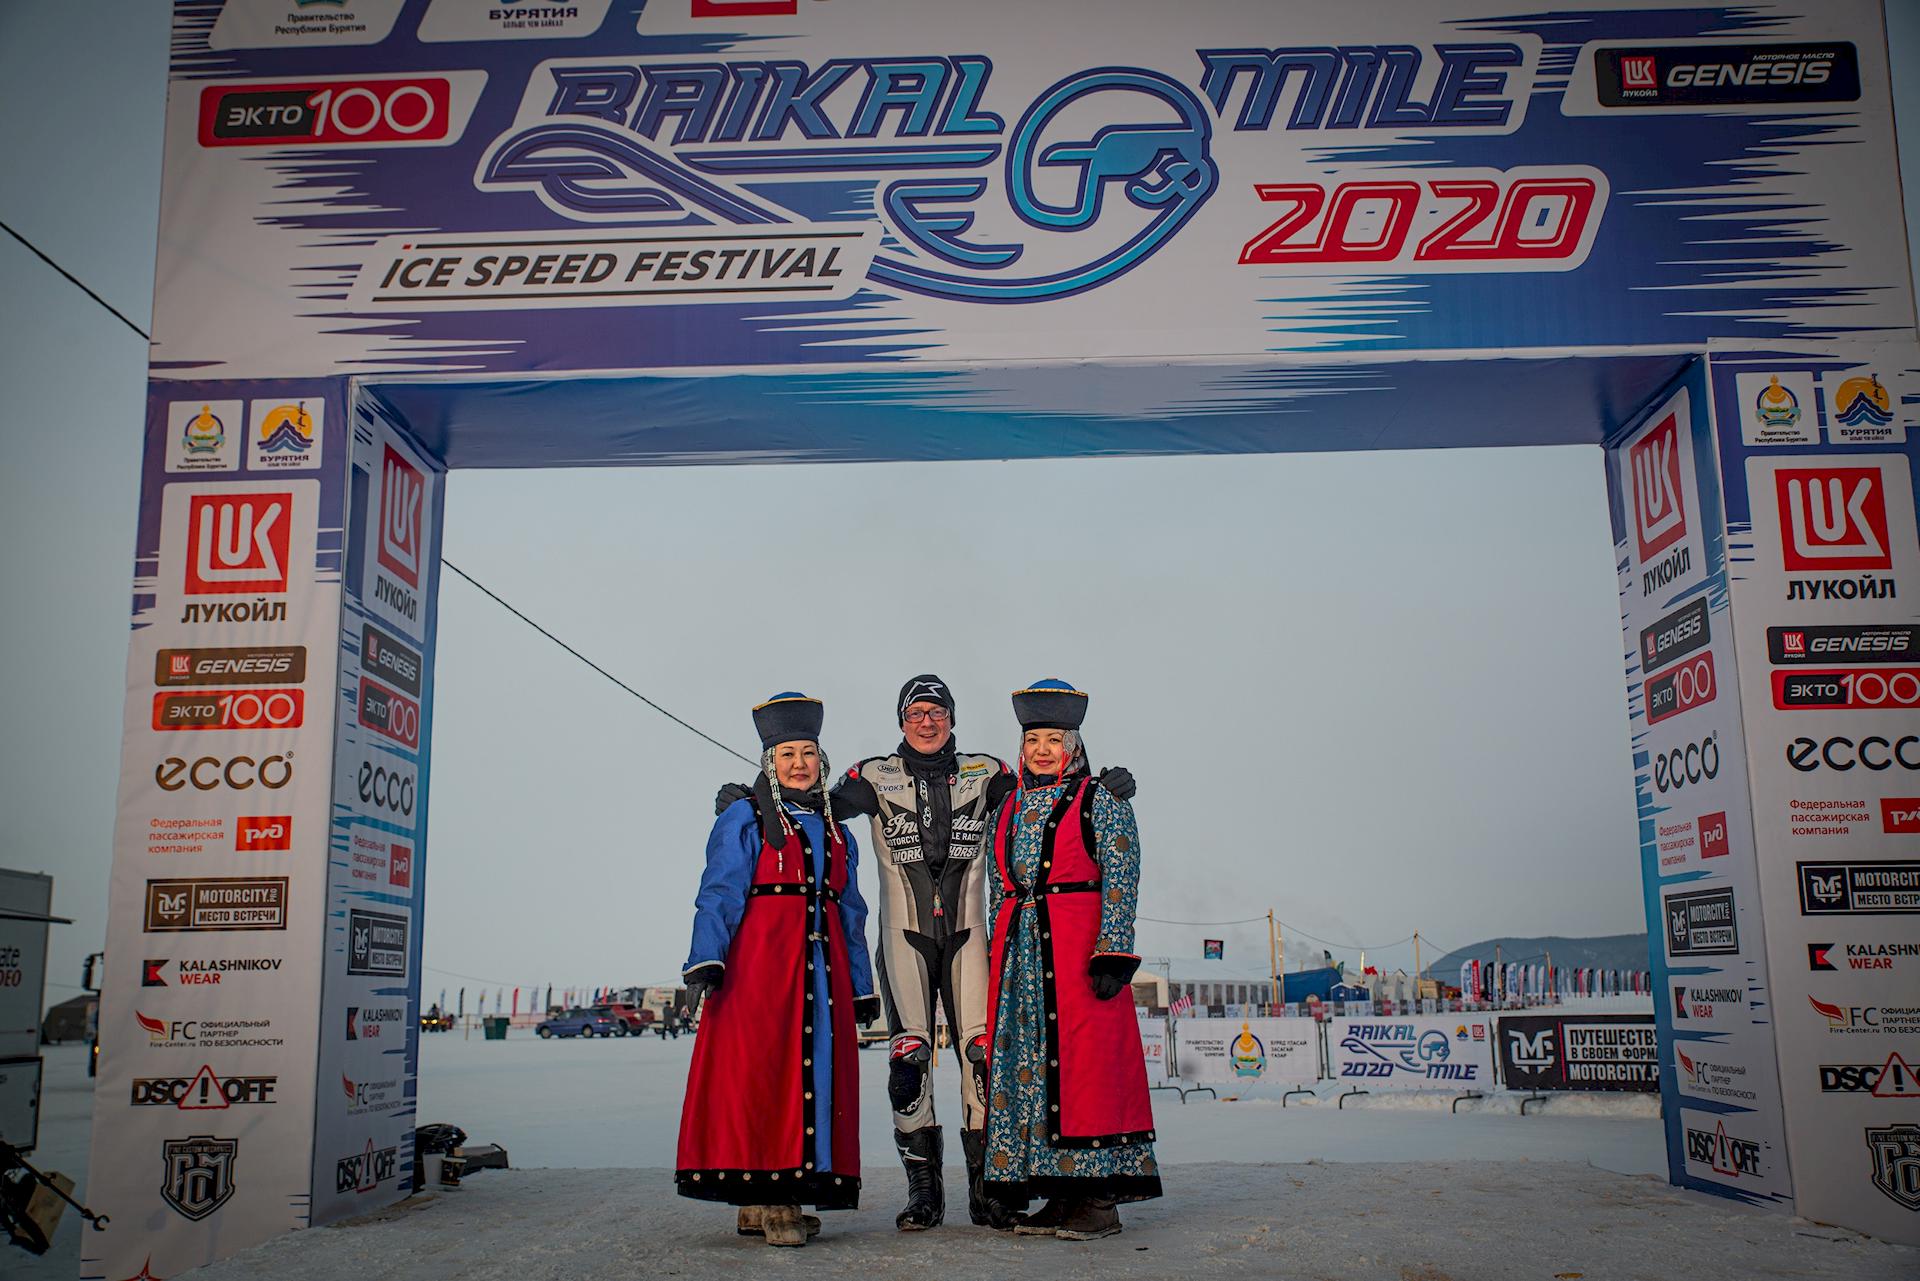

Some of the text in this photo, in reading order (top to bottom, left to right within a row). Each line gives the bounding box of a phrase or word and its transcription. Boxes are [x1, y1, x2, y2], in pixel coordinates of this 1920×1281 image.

[287, 13, 355, 23] Правительство
[489, 8, 578, 19] БУРЯТИЯ
[274, 24, 367, 35] Республики Бурятия
[1666, 62, 1832, 87] GENESIS
[550, 43, 1524, 145] BAIKAL MILE
[1622, 89, 1658, 97] ЛУКОЙЛ
[227, 85, 435, 136] ЭКТО 100
[1238, 178, 1595, 264] 2020
[464, 252, 618, 286] SPEED
[625, 246, 843, 283] FESTIVAL
[1643, 547, 1690, 597] ЛУКОЙЛ
[1787, 575, 1896, 600] ЛУКОЙЛ
[375, 574, 417, 623] ЛУКОЙЛ
[181, 598, 286, 623] ЛУКОЙЛ
[1657, 615, 1701, 652] GENESIS
[1810, 636, 1910, 652] GENESIS
[196, 658, 291, 674] GENESIS
[379, 648, 417, 682] GENESIS
[1652, 660, 1711, 709] ЭКТО 100
[1790, 672, 1920, 705] ЭКТО 100
[169, 693, 295, 725] ЭКТО 100
[366, 697, 417, 741] ЭКТО 100
[1655, 736, 1719, 793] ecco
[155, 755, 293, 791] ecco
[358, 760, 414, 816] ecco
[1790, 800, 1865, 810] Федеральная
[150, 818, 223, 829] Федеральная
[1791, 812, 1870, 824] пассажирская
[149, 831, 224, 842] пассажирская
[1792, 827, 1849, 836] компания
[148, 844, 203, 853] компания
[1857, 894, 1890, 905] МЕСТО
[199, 908, 276, 923] МЕСТО ВСТРЕЧИ
[180, 959, 282, 972] KALASHNIKOV
[1849, 958, 1893, 969] WEAR
[180, 974, 221, 985] WEAR
[1691, 988, 1743, 1003] KALASHNIKOV
[1692, 1004, 1713, 1018] WEAR
[1850, 1007, 1879, 1026] FC
[171, 1021, 197, 1040] FC
[200, 1020, 270, 1029] ОФИЦИАЛЬНЫЙ
[1348, 1025, 1417, 1040] BAIKAL
[215, 1039, 283, 1047] БЕЗОПАСНОСТИ
[1572, 1048, 1578, 1059] В
[1582, 1047, 1619, 1059] СВОЕМ
[1341, 1062, 1479, 1080] 2020 MILE
[1696, 1062, 1710, 1084] FC
